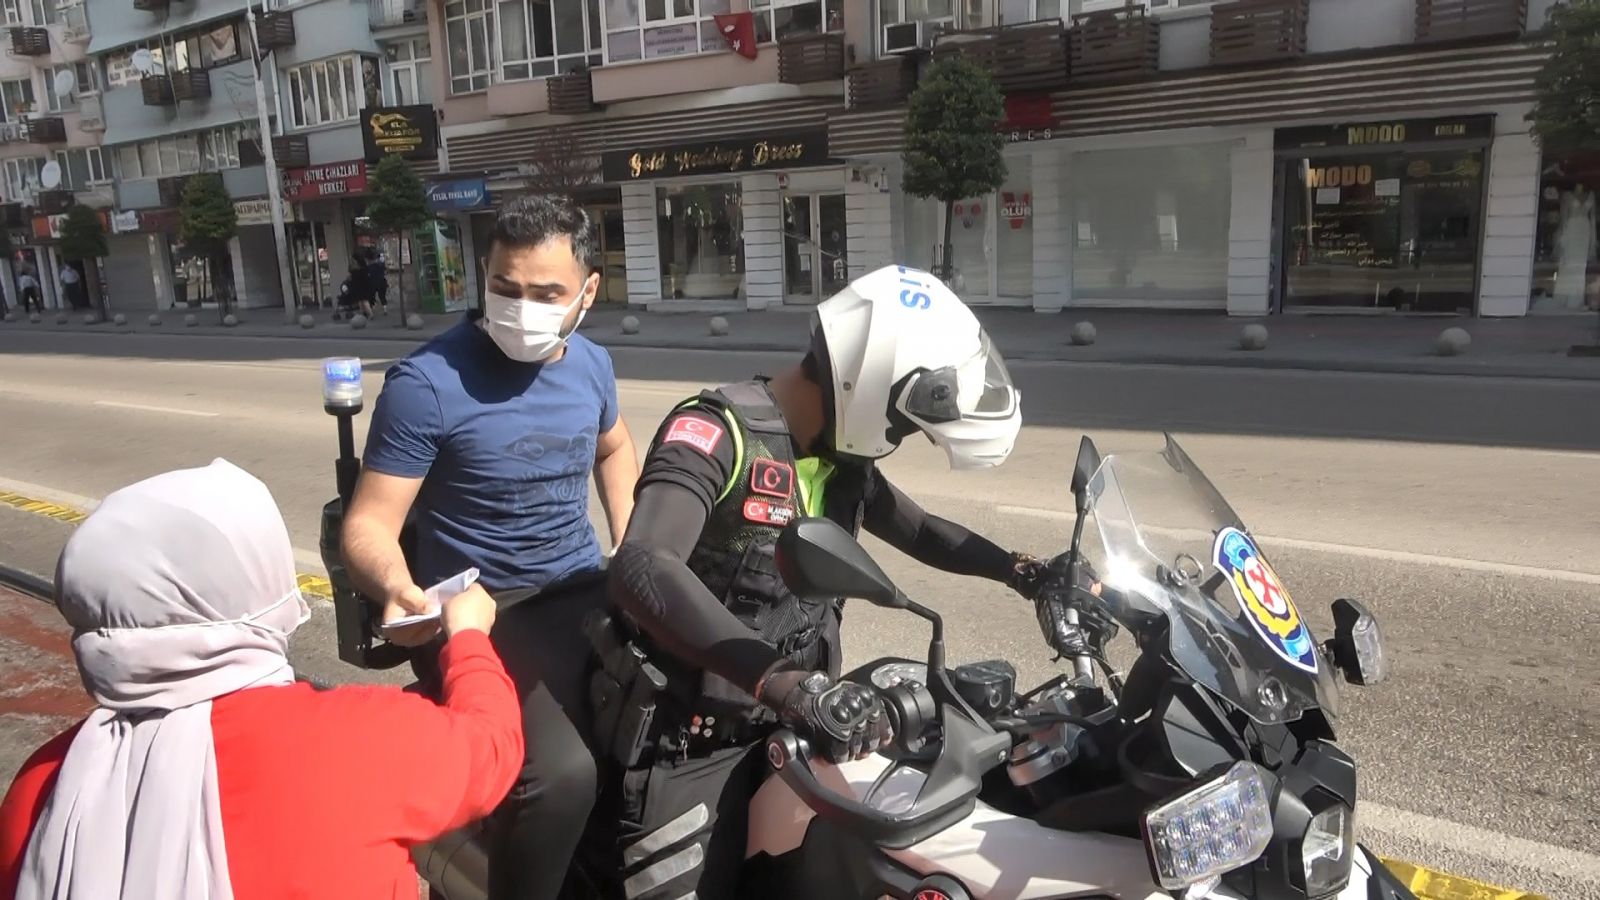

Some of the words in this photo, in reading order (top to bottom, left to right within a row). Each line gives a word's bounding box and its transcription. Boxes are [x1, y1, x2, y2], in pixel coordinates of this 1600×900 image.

[629, 152, 667, 178] Gold
[674, 147, 744, 172] Wedding
[752, 141, 803, 166] Dress
[1306, 164, 1372, 188] MODO
